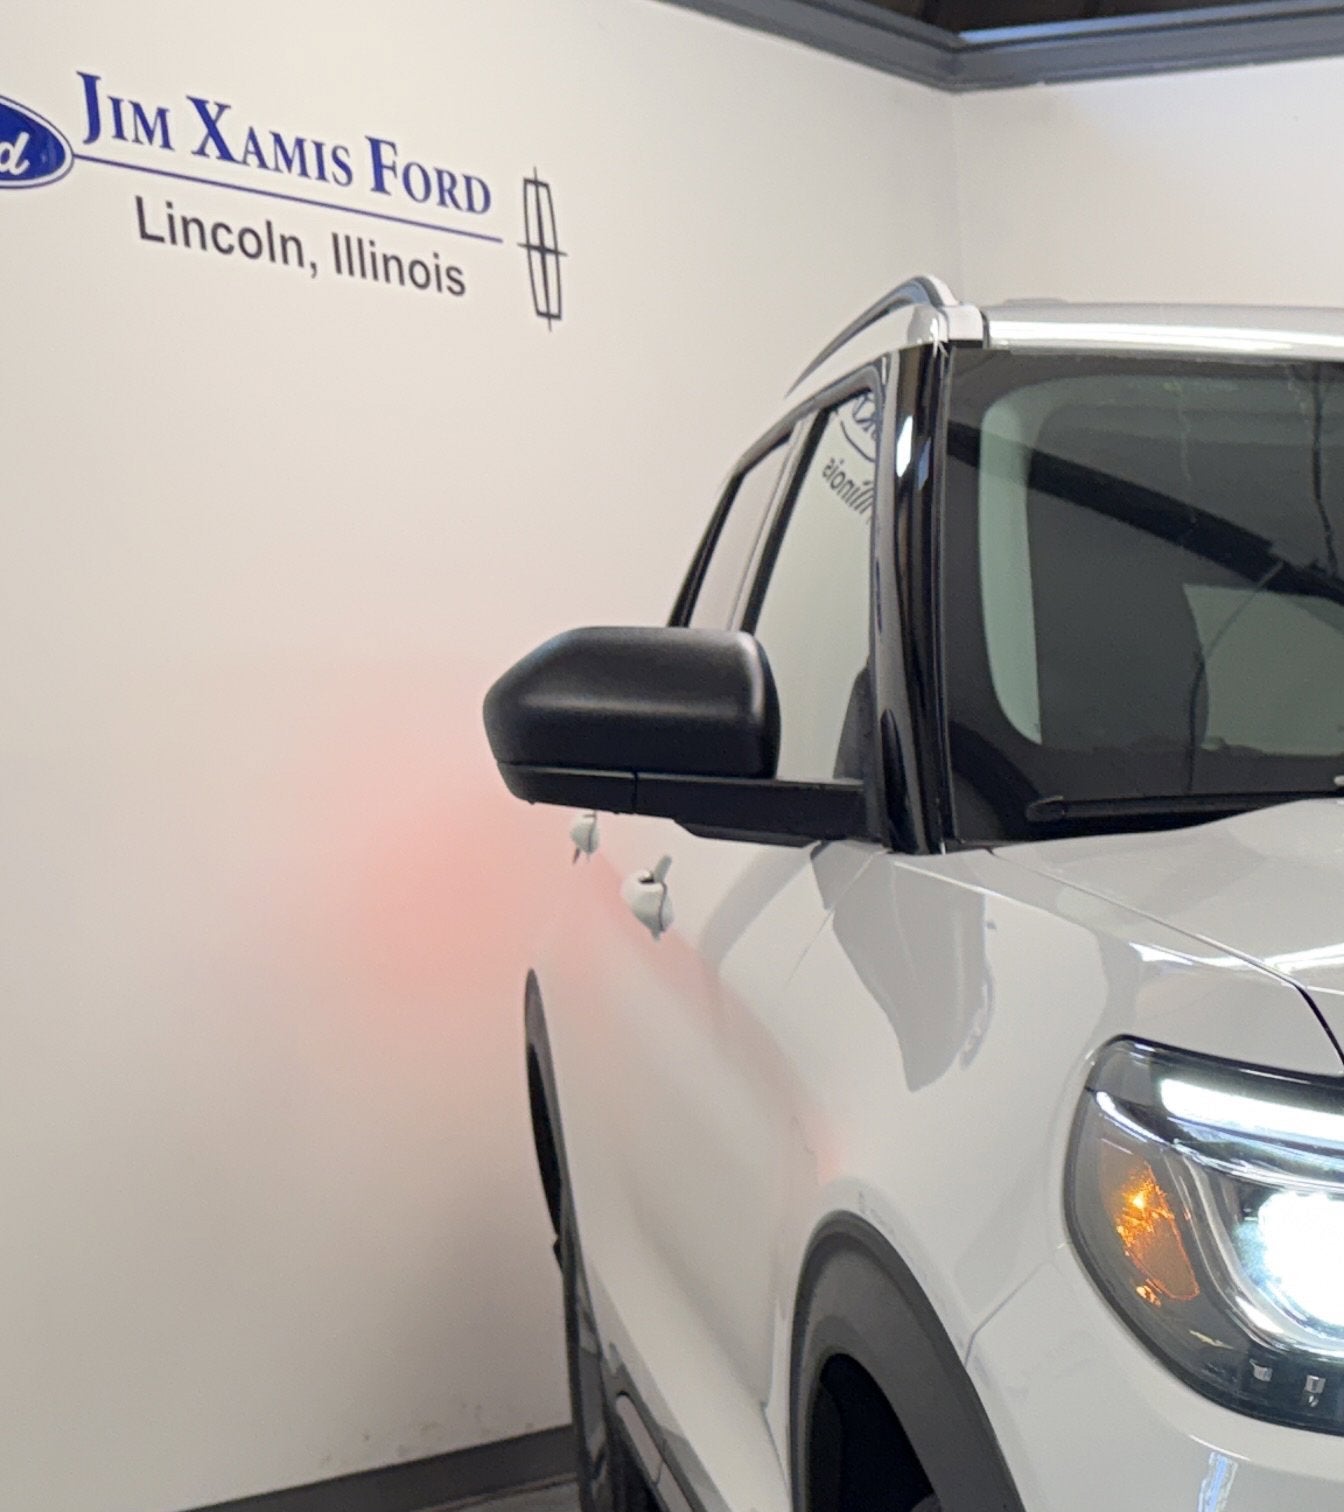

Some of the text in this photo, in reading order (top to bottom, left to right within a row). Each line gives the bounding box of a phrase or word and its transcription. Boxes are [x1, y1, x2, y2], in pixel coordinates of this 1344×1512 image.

[76, 71, 492, 215] JIM XAMIS FORD
[135, 195, 467, 297] Lincoln, Illinois
